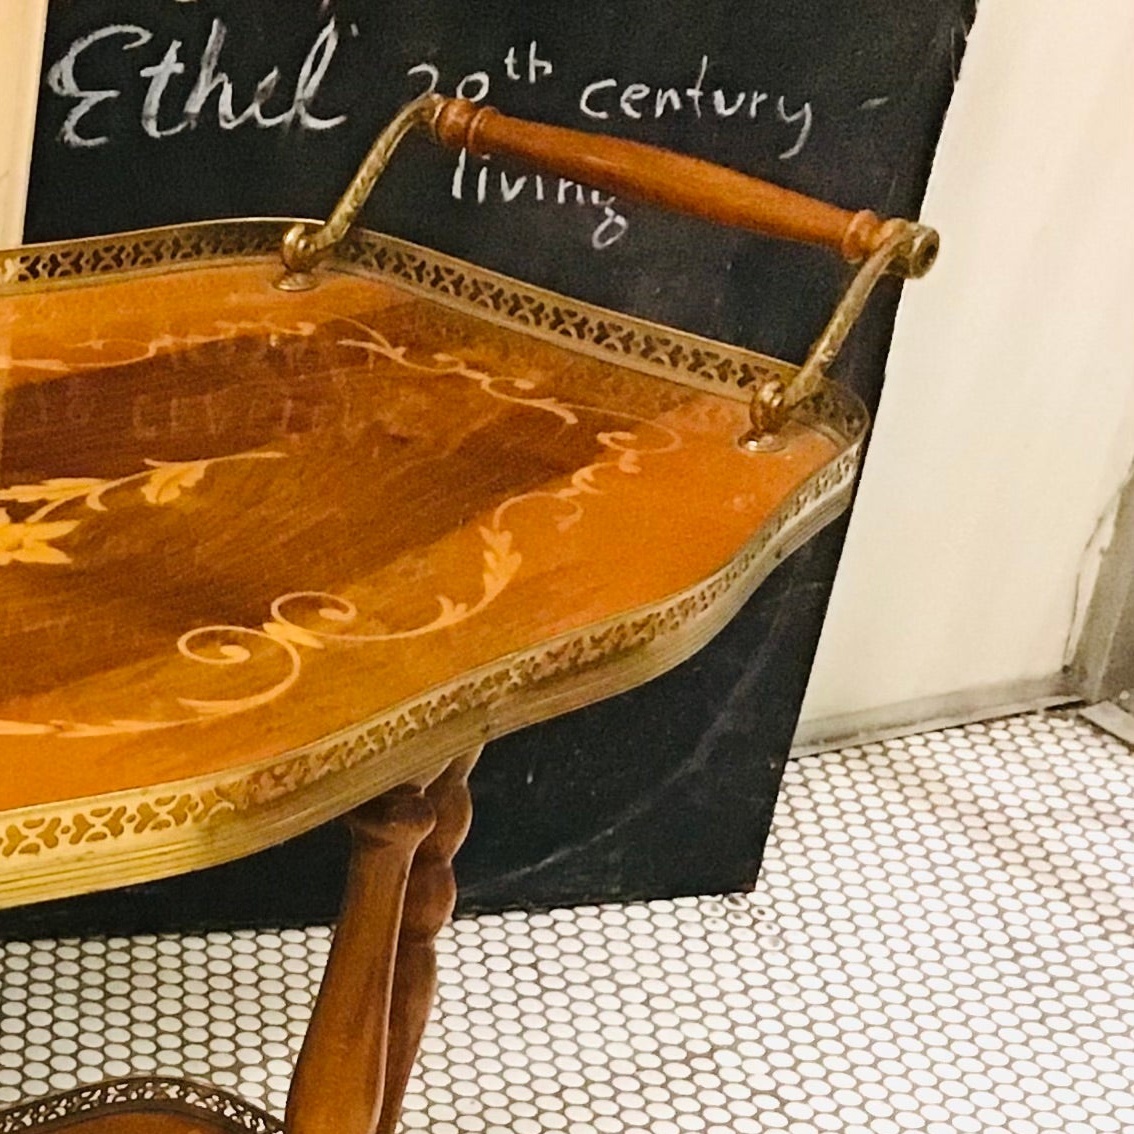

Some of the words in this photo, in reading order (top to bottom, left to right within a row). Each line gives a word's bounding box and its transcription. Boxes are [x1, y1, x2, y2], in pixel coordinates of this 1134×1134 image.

[48, 17, 347, 148] Ethel
[579, 55, 812, 159] century
[451, 146, 629, 250] living
